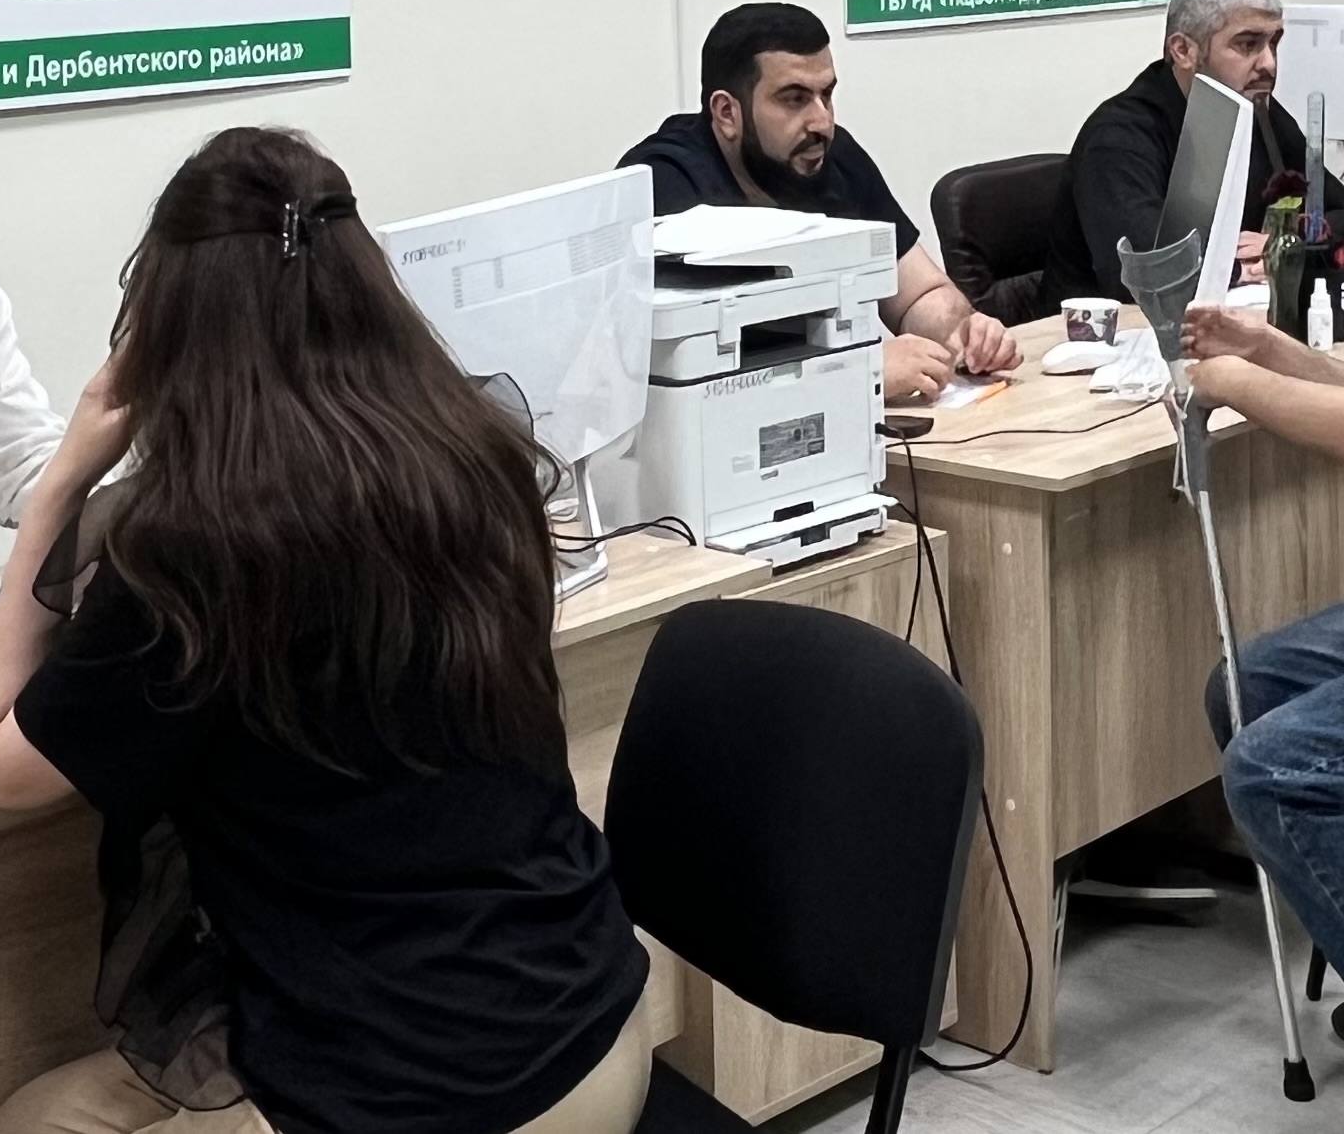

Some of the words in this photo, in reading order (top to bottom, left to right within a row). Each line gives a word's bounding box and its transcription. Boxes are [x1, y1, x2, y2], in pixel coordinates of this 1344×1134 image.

[2, 63, 18, 85] и
[25, 48, 203, 88] Дербентского
[209, 39, 304, 74] района»
